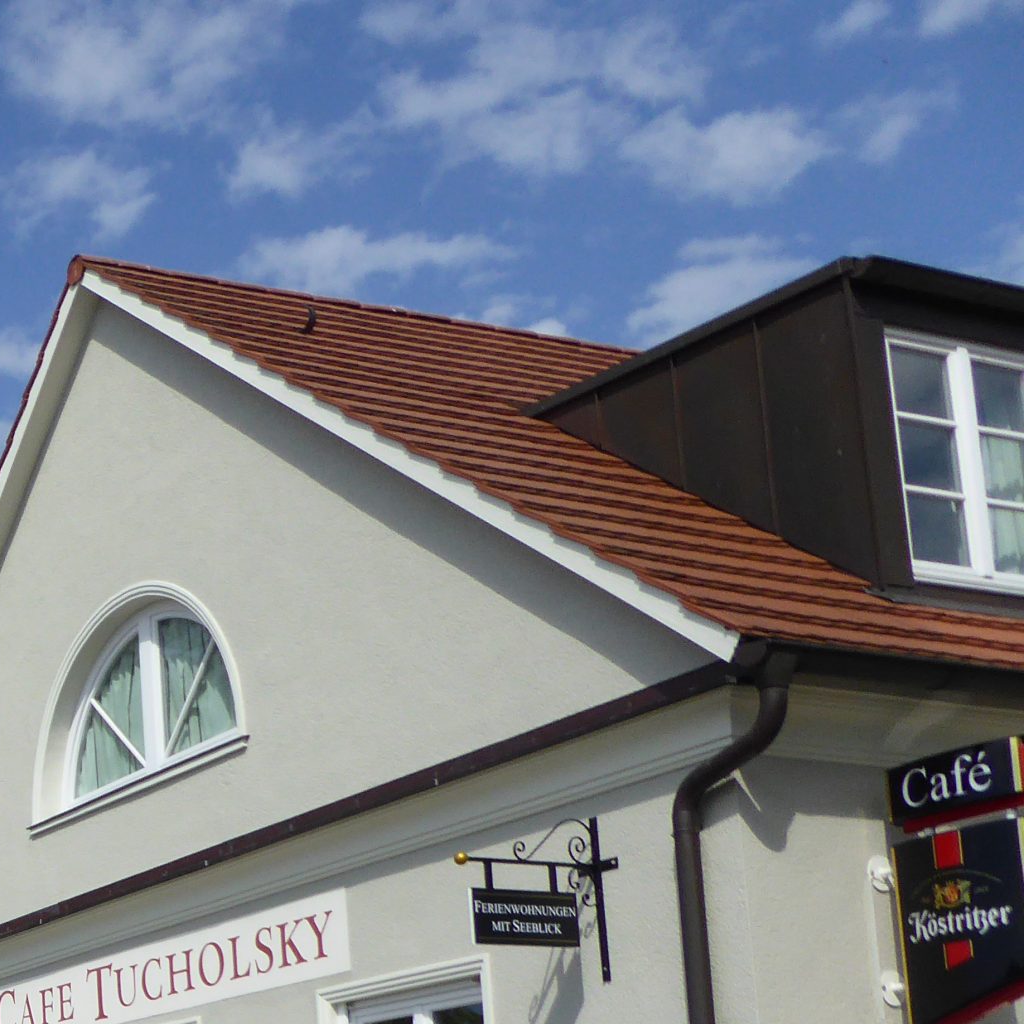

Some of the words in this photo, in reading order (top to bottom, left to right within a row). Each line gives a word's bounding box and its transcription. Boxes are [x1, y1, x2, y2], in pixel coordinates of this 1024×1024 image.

[902, 750, 993, 808] Café
[474, 899, 577, 918] FERIENWOHNUNGEN
[491, 920, 511, 932] MIT
[512, 919, 563, 935] SEEBLICK
[907, 903, 1014, 945] Köstritzer
[86, 910, 333, 1021] TUCHOLSKY
